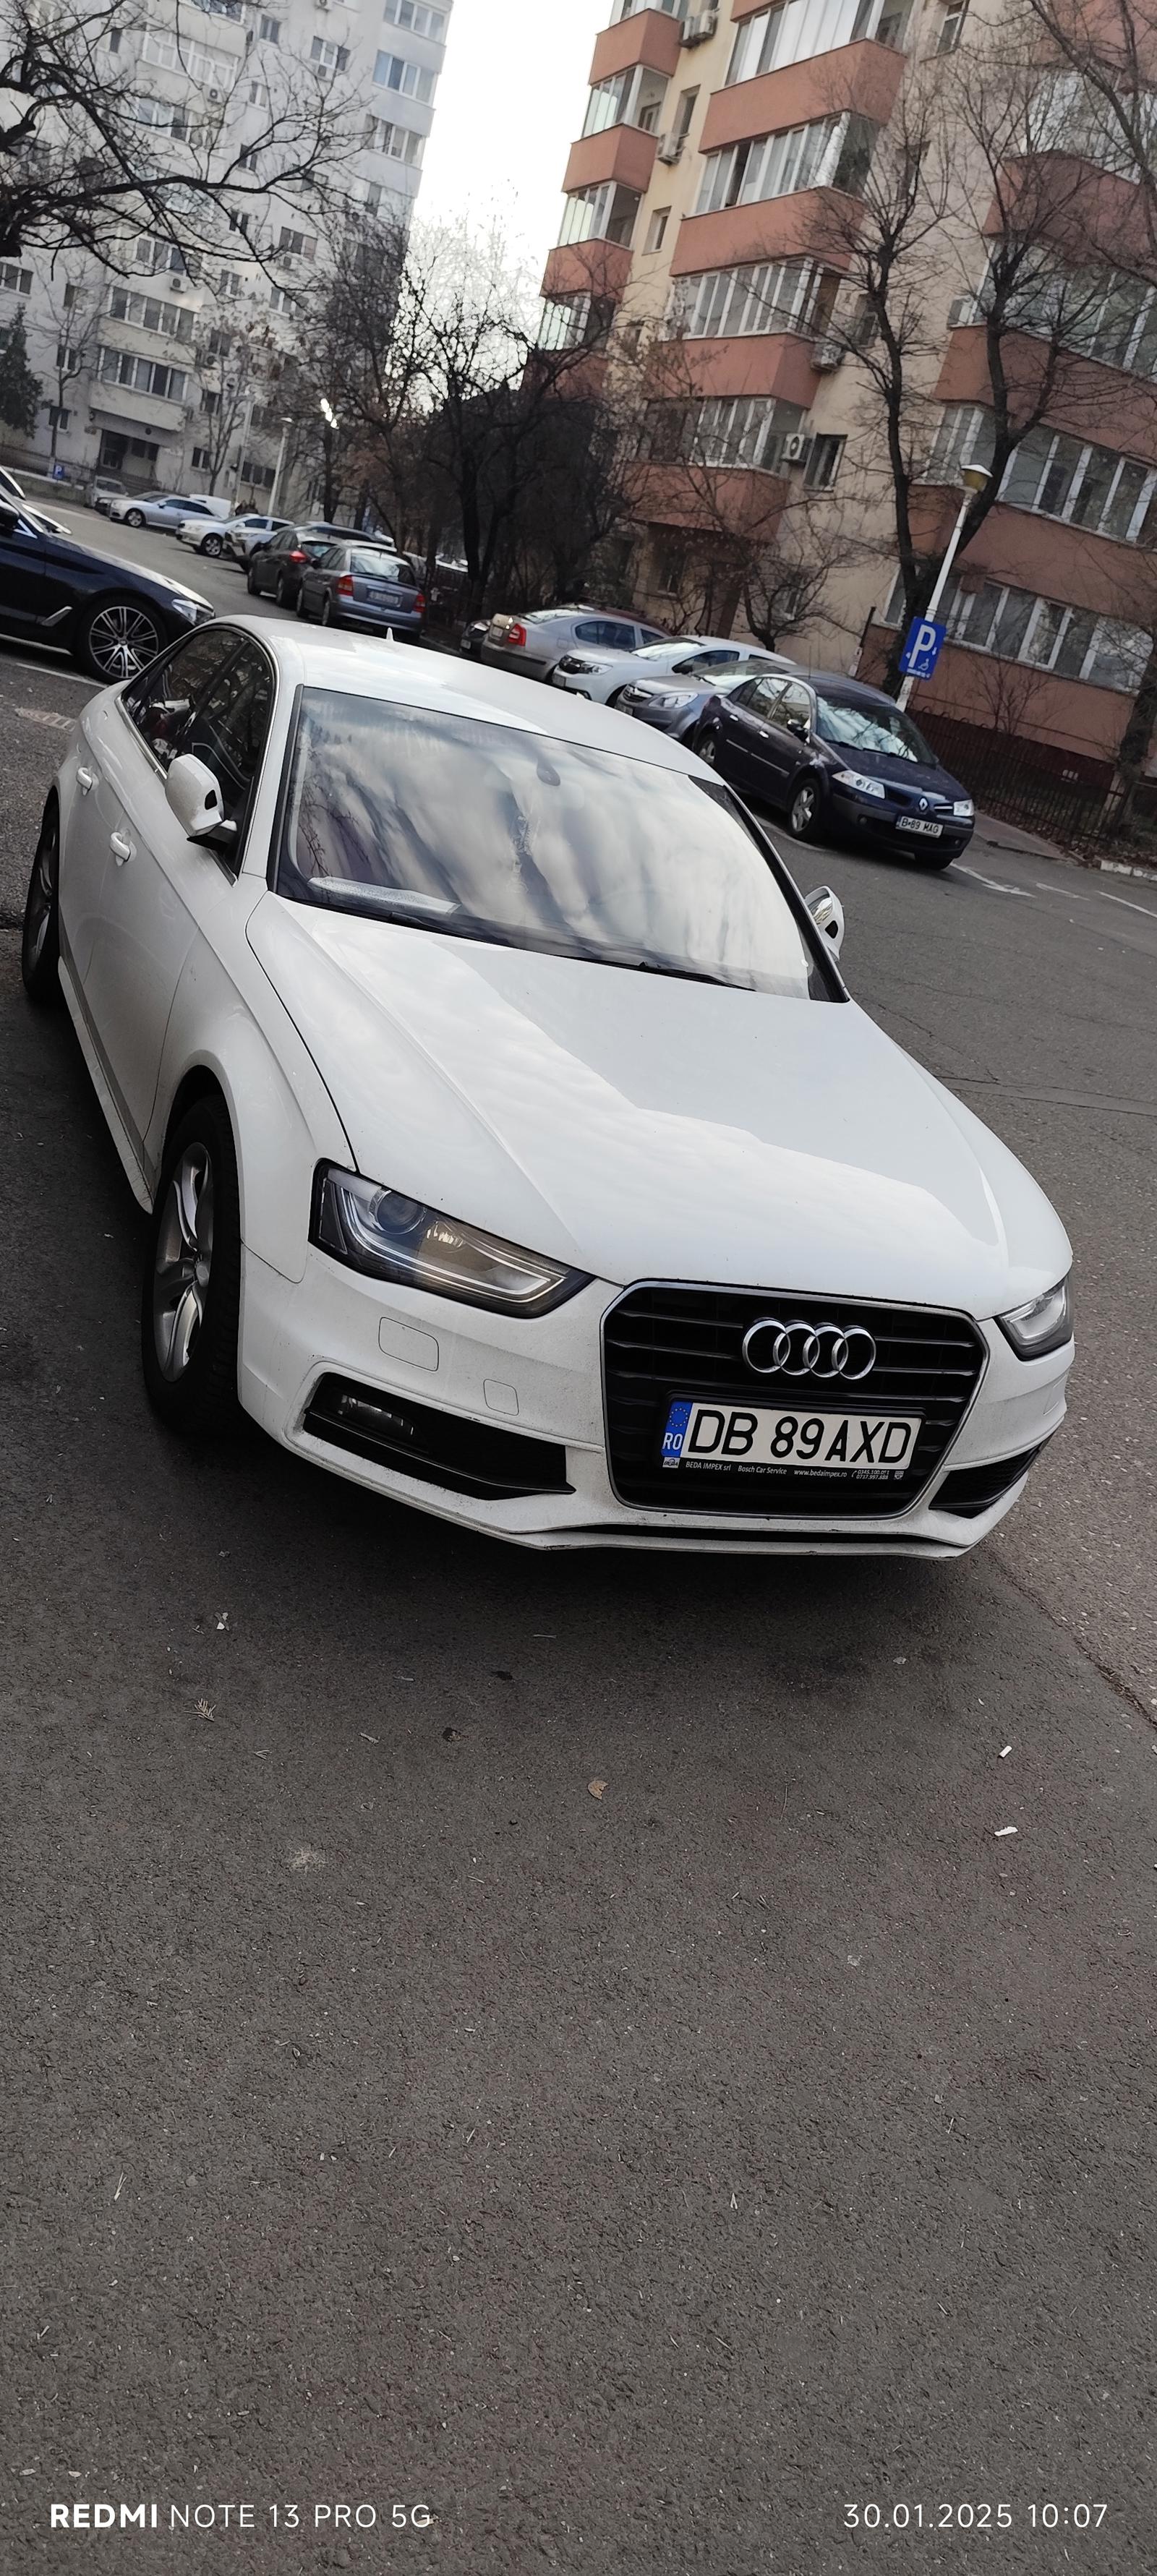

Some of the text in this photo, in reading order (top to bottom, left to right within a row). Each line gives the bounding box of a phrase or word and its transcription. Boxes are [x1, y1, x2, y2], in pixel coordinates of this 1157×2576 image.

[908, 624, 936, 668] P
[662, 1432, 682, 1450] RO
[688, 1409, 758, 1455] DB
[794, 1469, 848, 1478] www.bedaimpex.ro
